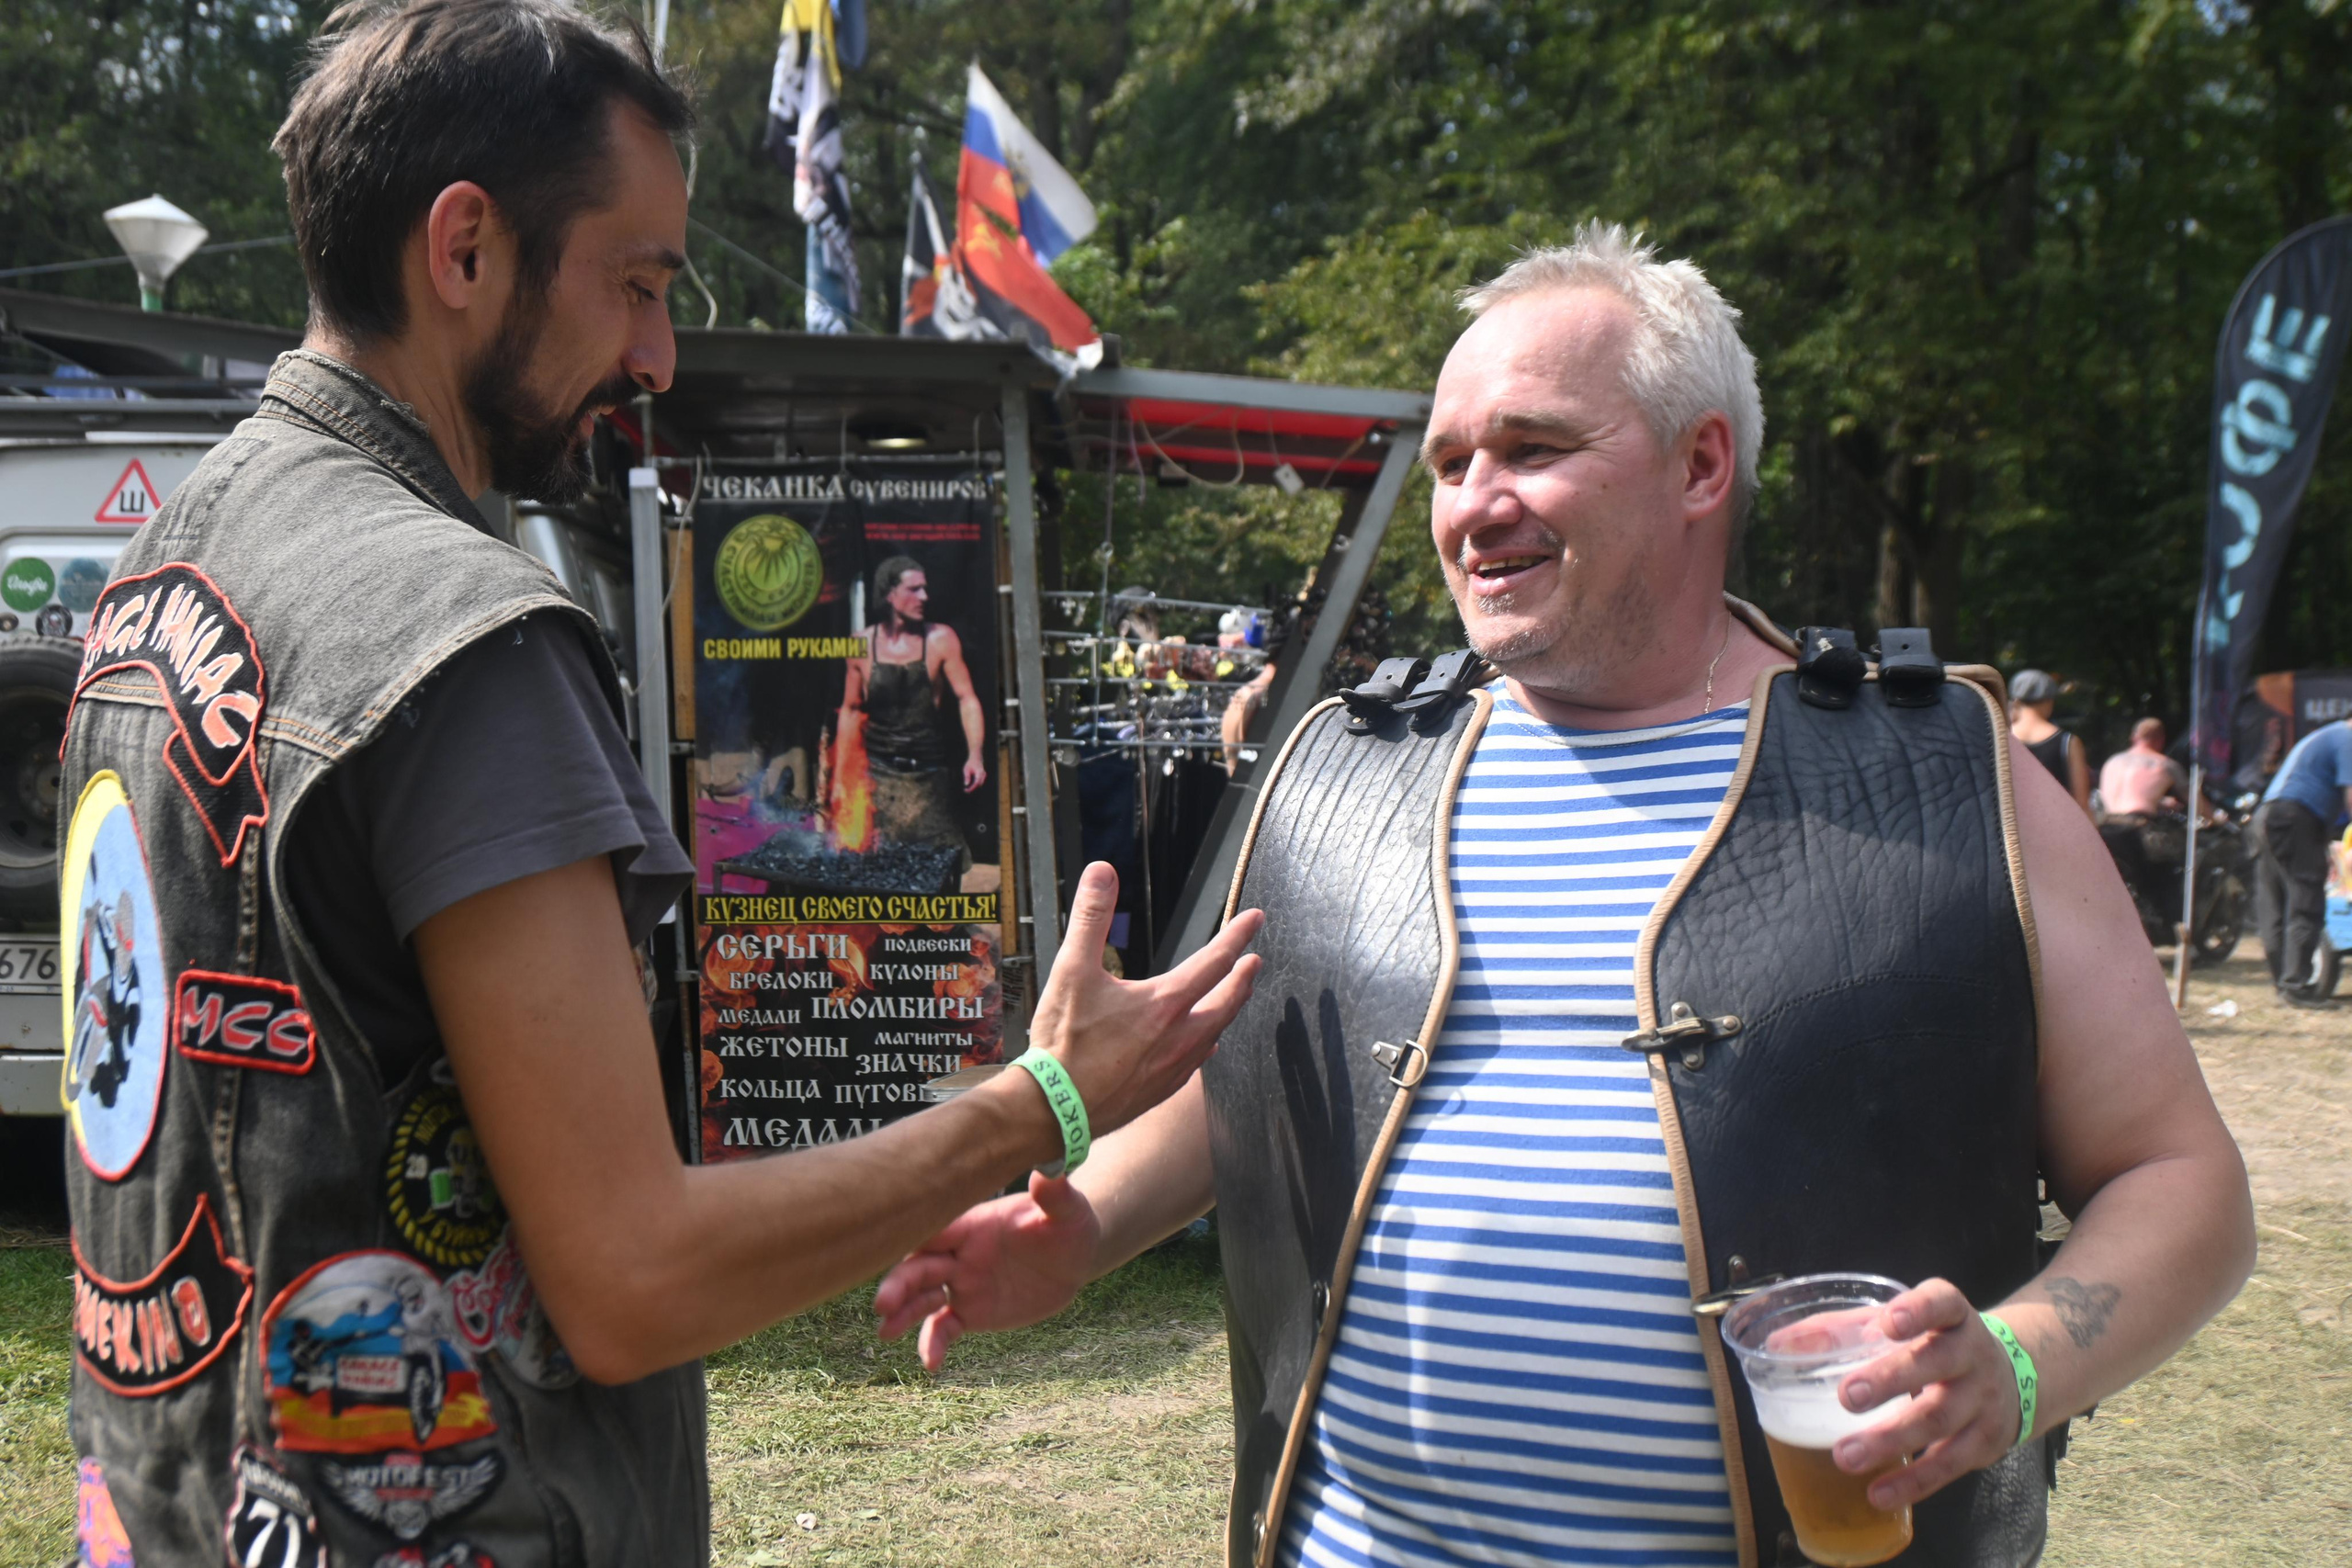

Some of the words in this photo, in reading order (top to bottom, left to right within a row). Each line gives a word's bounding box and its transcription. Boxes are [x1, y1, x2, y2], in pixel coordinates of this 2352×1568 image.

[703, 475, 845, 499] ЧЕКАНКА
[850, 479, 987, 502] СУВЕНИРОВ
[119, 490, 144, 513] Ш
[704, 638, 780, 660] СВОИМИ
[787, 637, 868, 659] РУКАМИ!
[705, 897, 797, 926] КУЗНЕЦ
[802, 897, 883, 919] СВОЕГО
[888, 894, 997, 919] СЧАСТЬЯ!
[717, 933, 848, 960] СЕРЬГИ
[885, 938, 971, 953] ПОДВЕСКИ
[729, 971, 833, 990] БРЕЛОКИ
[870, 964, 958, 985] КУЛОНЫ
[718, 1009, 800, 1025] МЕДАЛИ
[811, 997, 984, 1020] ПЛОМБИРЫ
[183, 986, 309, 1055] MCC
[719, 1035, 849, 1057] ЖЕТОНЫ
[875, 1032, 972, 1046] МАГНИТЫ
[855, 1054, 962, 1076] ЗНАЧКИ
[720, 1079, 822, 1103] КОЛЬЦА
[1035, 1060, 1085, 1155] JOKERS
[723, 1118, 883, 1150] МЕДАЛ
